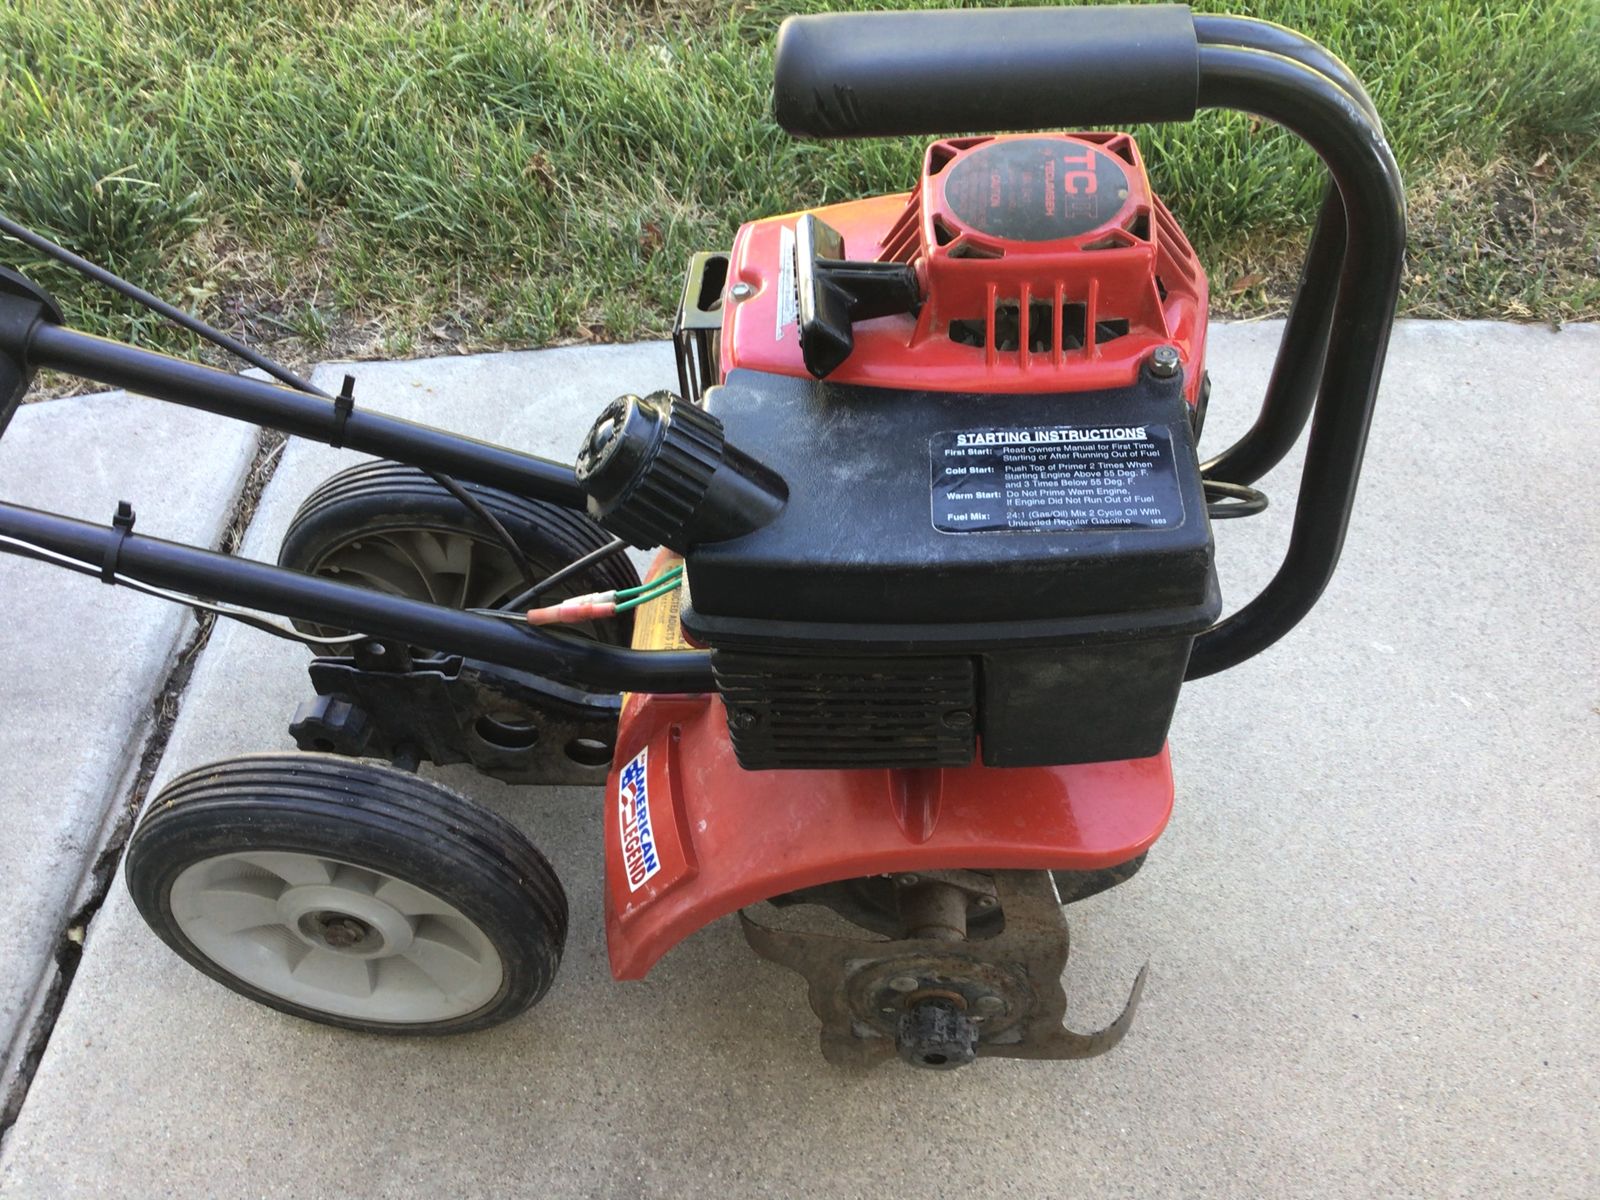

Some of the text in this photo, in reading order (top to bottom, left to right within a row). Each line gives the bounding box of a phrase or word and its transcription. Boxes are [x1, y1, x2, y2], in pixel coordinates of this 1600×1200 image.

[1063, 149, 1097, 195] TC
[957, 427, 1147, 445] STARTING INSTRUCTIONS
[944, 448, 993, 456] First Start:
[1002, 446, 1026, 454] Read
[1028, 445, 1062, 454] Owners
[1064, 444, 1096, 452] Manual
[1098, 442, 1110, 450] for
[1112, 442, 1132, 450] First
[1003, 454, 1036, 462] Starting
[1072, 452, 1109, 460] Running
[946, 466, 994, 475] Cold Start:
[1030, 464, 1046, 472] Top
[1058, 462, 1087, 470] Primer
[1004, 472, 1038, 482] Starting
[1040, 472, 1070, 480] Engine
[1117, 470, 1138, 478] Deg.
[1061, 478, 1088, 486] Below
[1104, 478, 1126, 486] Deg.
[946, 492, 974, 500] Warm
[1006, 490, 1020, 498] Do
[1014, 498, 1046, 507] Engine
[948, 512, 990, 521] Fuel Mix:
[1028, 510, 1068, 519] (Gas/Oil)
[1070, 510, 1087, 518] Mix
[1097, 508, 1122, 517] Cycle
[1124, 508, 1138, 516] Oil
[1140, 507, 1162, 515] With
[1008, 516, 1132, 528] Unleaded Regular Gasoline
[636, 766, 657, 873] AMERICAN
[622, 812, 646, 885] LEGEND
